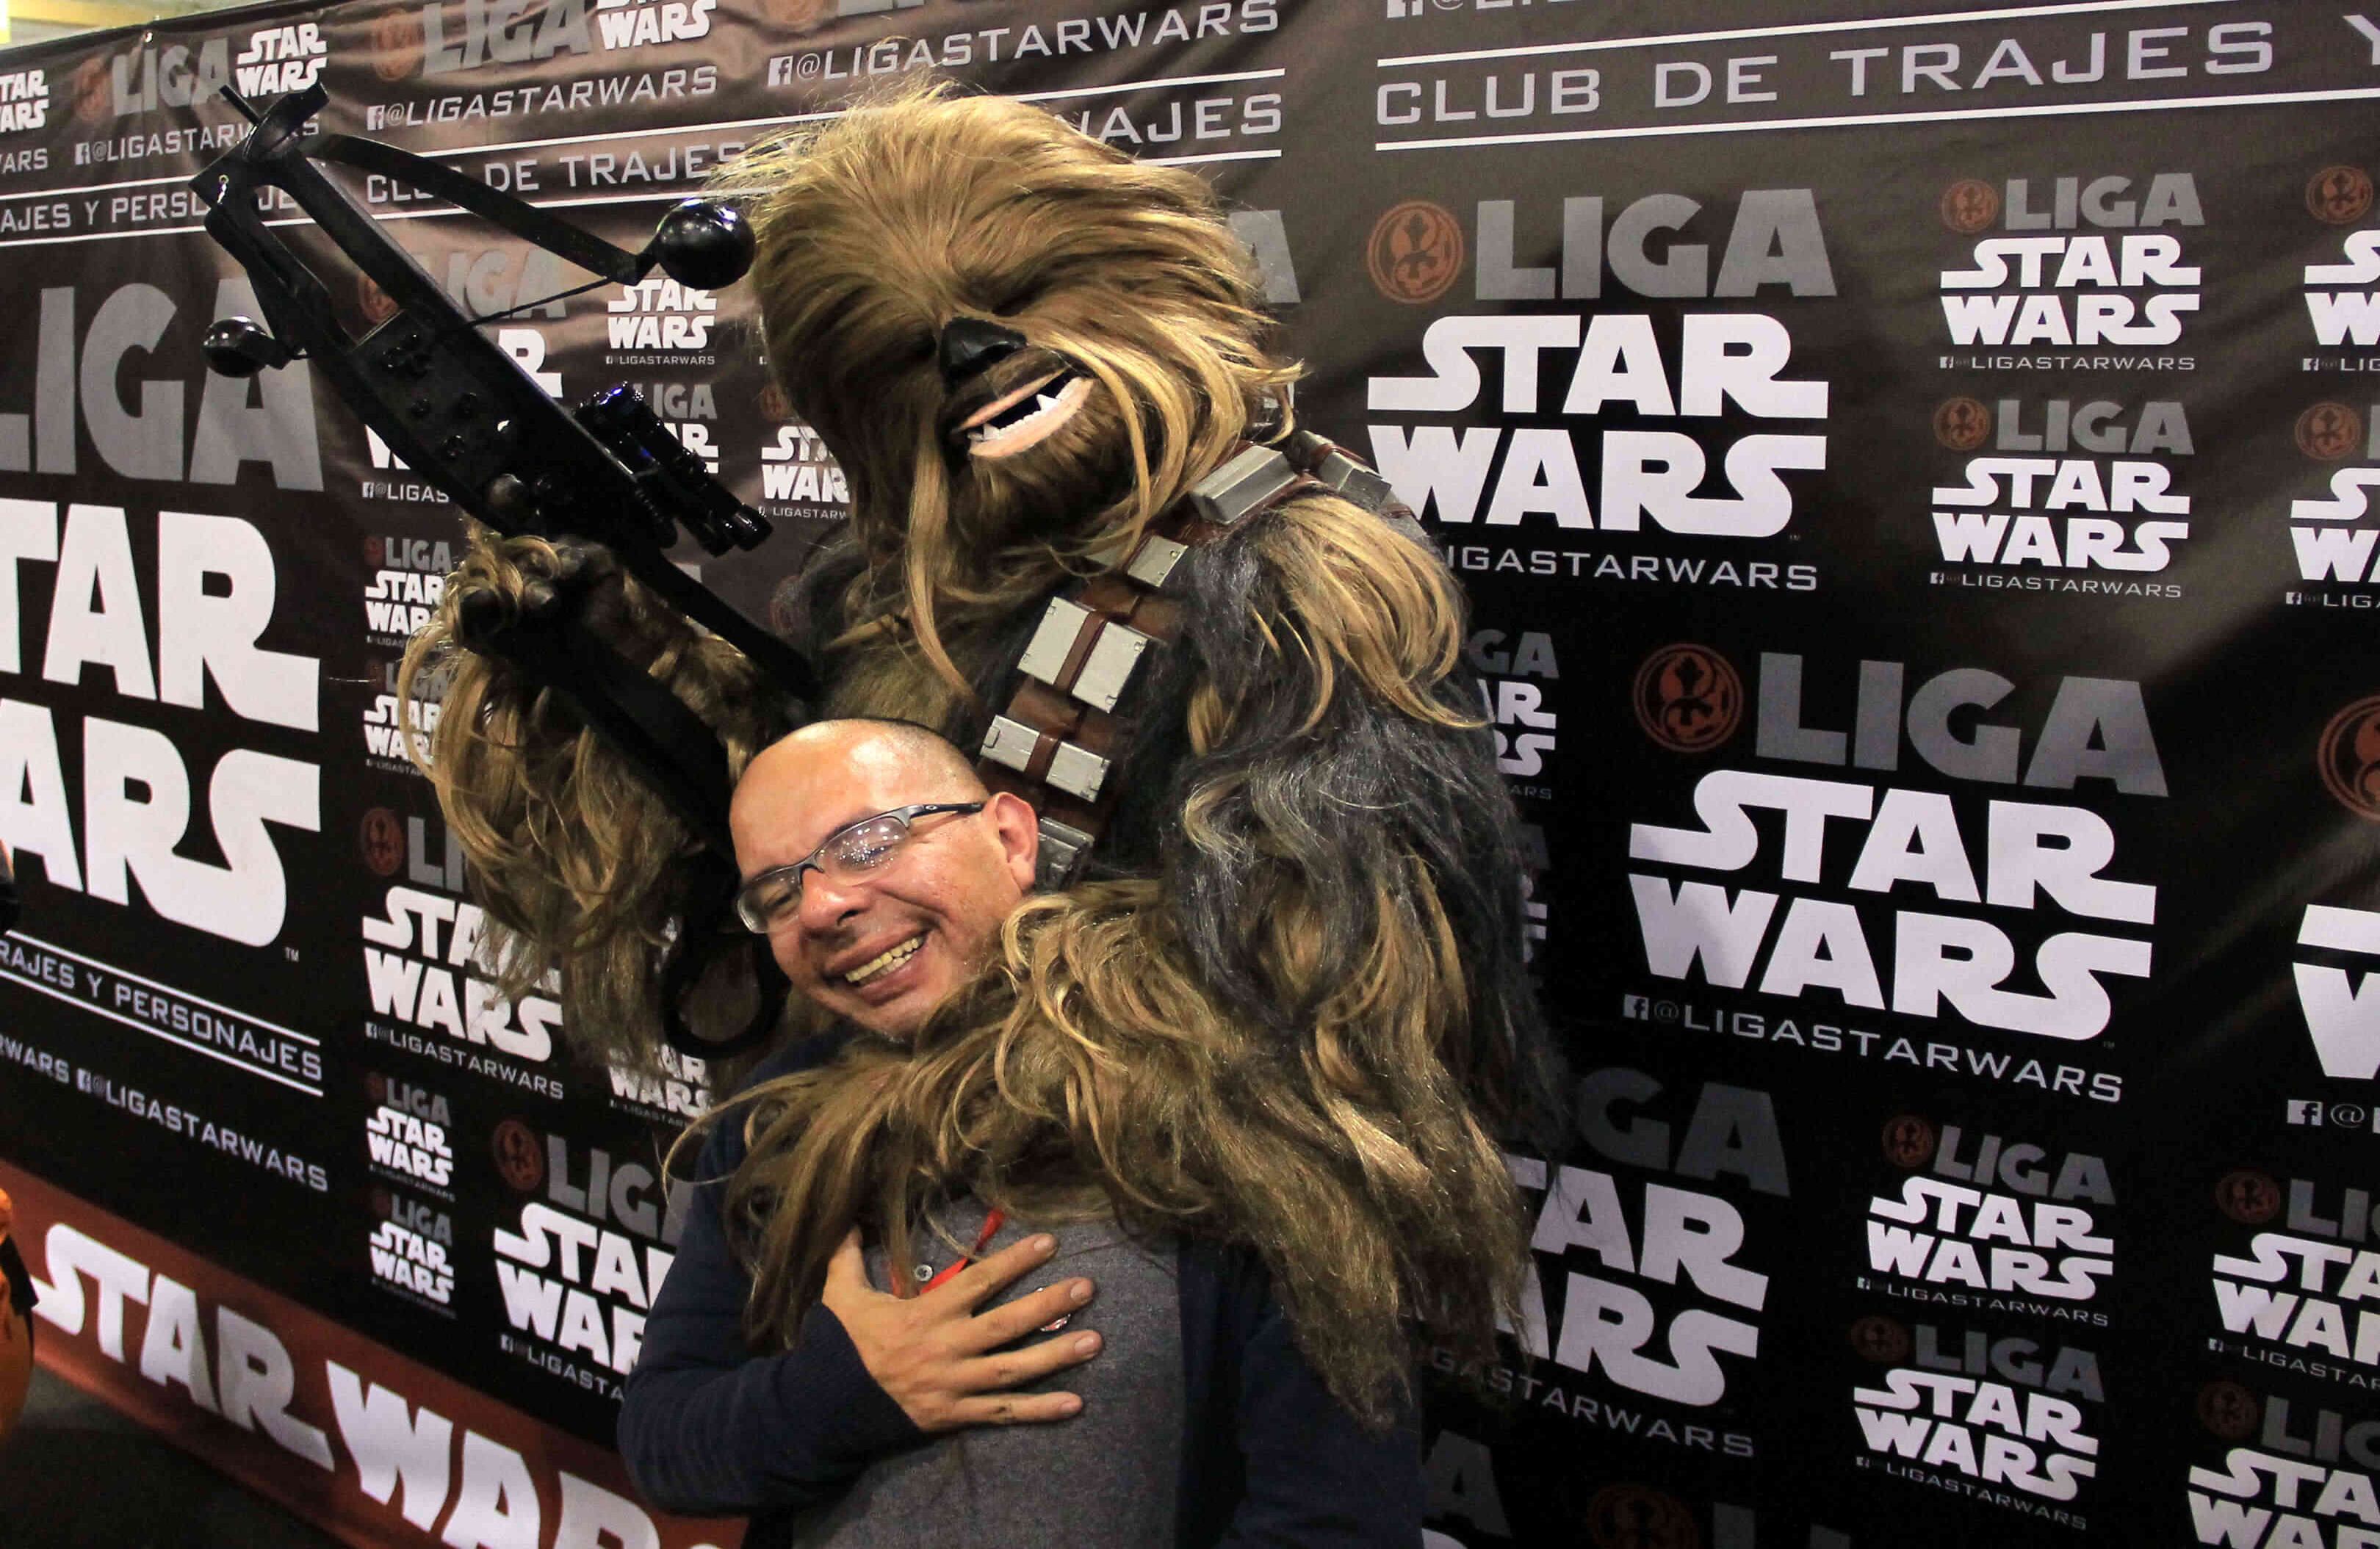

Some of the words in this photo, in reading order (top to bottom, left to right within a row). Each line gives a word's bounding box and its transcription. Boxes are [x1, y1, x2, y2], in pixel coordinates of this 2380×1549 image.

[237, 23, 327, 65] STAR
[423, 0, 588, 73] LIGA
[598, 1, 717, 50] WARS
[0, 69, 50, 102] TAR
[112, 38, 229, 116] LIGA
[236, 57, 327, 98] WARS
[1376, 69, 1601, 125] CLUB
[1654, 55, 1778, 108] DE
[1829, 21, 2273, 96] TRAJES
[0, 98, 50, 133] ARS
[485, 159, 540, 192] DE
[2005, 173, 2205, 230] LIGA
[1, 203, 71, 232] AJES
[84, 201, 100, 225] Y
[1475, 188, 1836, 300] LIGA
[411, 248, 566, 319] IGA
[1941, 234, 2201, 288] STAR
[607, 316, 715, 349] WARS
[1941, 294, 2200, 345] WARS
[1367, 314, 1829, 419] STAR
[653, 384, 718, 419] IGA
[1996, 400, 2195, 455] LIGA
[762, 465, 850, 503] WAR
[1367, 425, 1828, 537] WARS
[1933, 458, 2190, 514] STAR
[385, 537, 452, 574] LIGA
[1448, 546, 1817, 591] IGASTARWARS
[1932, 513, 2189, 571] WARS
[1468, 629, 1559, 679] GA
[1756, 651, 2169, 797] LIGA
[0, 698, 320, 947] ARS
[1629, 769, 2157, 925] STAR
[1629, 873, 2152, 1041] WARS
[86, 972, 103, 998] Y
[115, 983, 322, 1082] PERSONAJES
[364, 947, 563, 1062] WARS
[386, 1077, 451, 1127] LIGA
[367, 1105, 452, 1158] STAR
[368, 1132, 453, 1186] WARS
[1575, 1066, 1791, 1197] GA
[1933, 1124, 2116, 1205] LIGA
[392, 1194, 452, 1246] LIGA
[1869, 1176, 2114, 1254] STAR
[370, 1221, 454, 1277] STAR
[370, 1246, 455, 1304] WARS
[1867, 1219, 2113, 1300] WARS
[32, 1223, 334, 1472] STAR
[1915, 1324, 2105, 1402] LIGA
[1853, 1368, 2099, 1456] STAR
[1854, 1407, 2096, 1501] WARS
